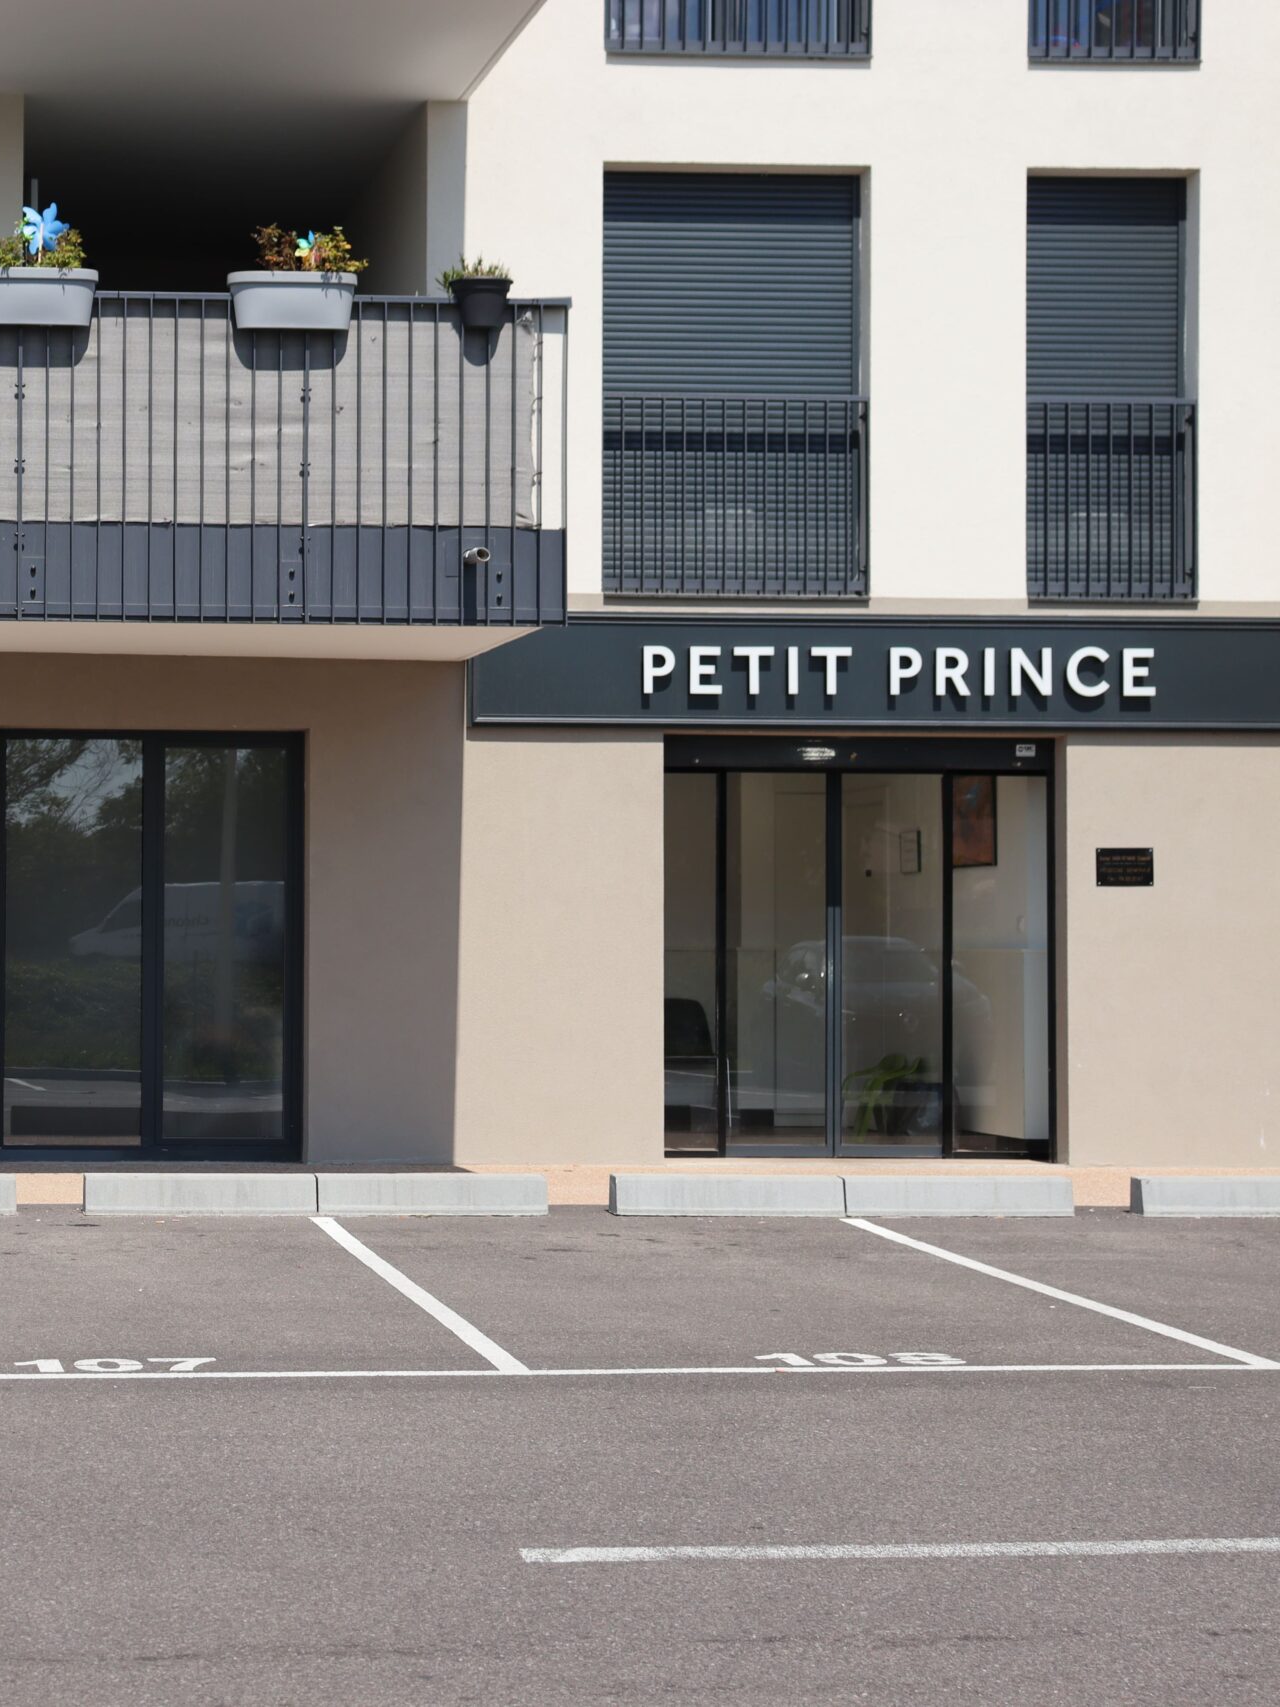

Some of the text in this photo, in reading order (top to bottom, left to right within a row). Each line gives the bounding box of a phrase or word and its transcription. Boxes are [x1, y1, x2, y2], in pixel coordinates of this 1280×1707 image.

[642, 645, 1156, 697] PETIT PRINCE
[14, 1357, 217, 1373] 107
[754, 1352, 967, 1366] 108
